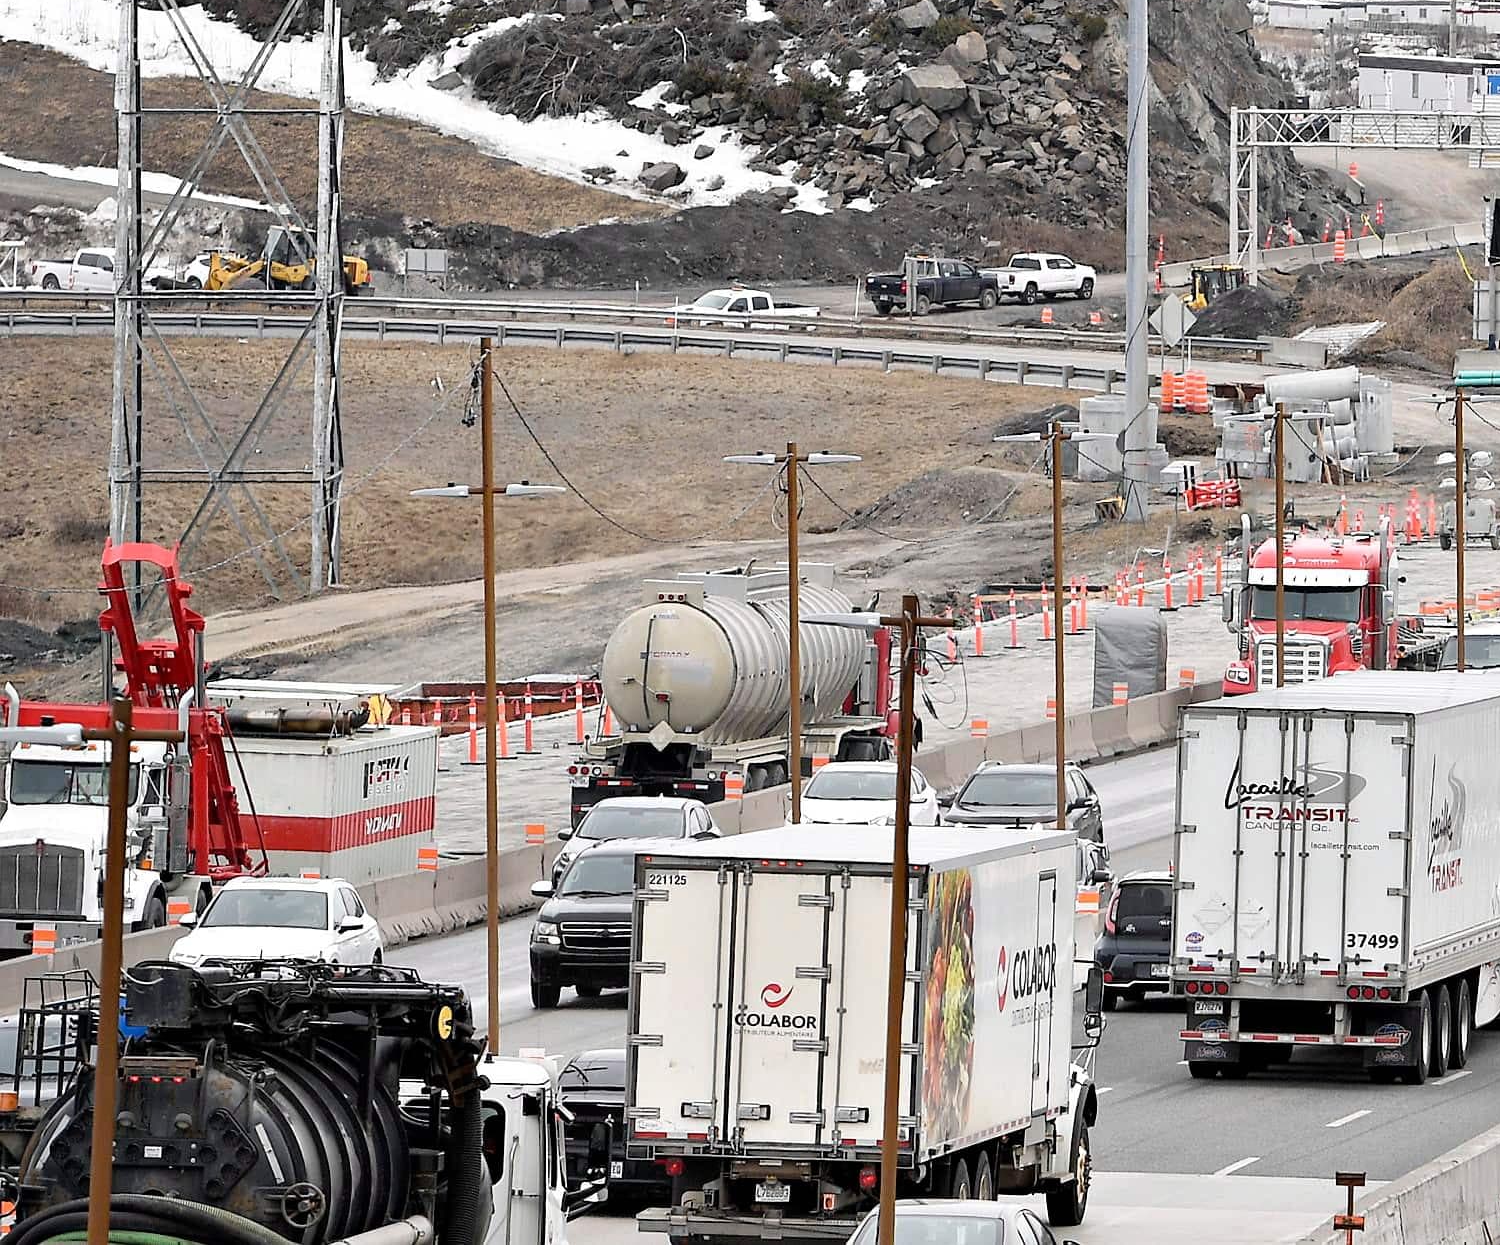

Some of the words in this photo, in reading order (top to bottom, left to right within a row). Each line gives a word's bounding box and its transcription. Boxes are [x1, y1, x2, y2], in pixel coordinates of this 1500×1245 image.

[1242, 806, 1347, 823] TRANSIT
[1310, 841, 1380, 851] lacailletrnsit.com
[649, 874, 687, 885] 221125
[1346, 933, 1400, 950] 37499
[1013, 943, 1057, 1000] COLABOR
[735, 1013, 817, 1029] COLABOR
